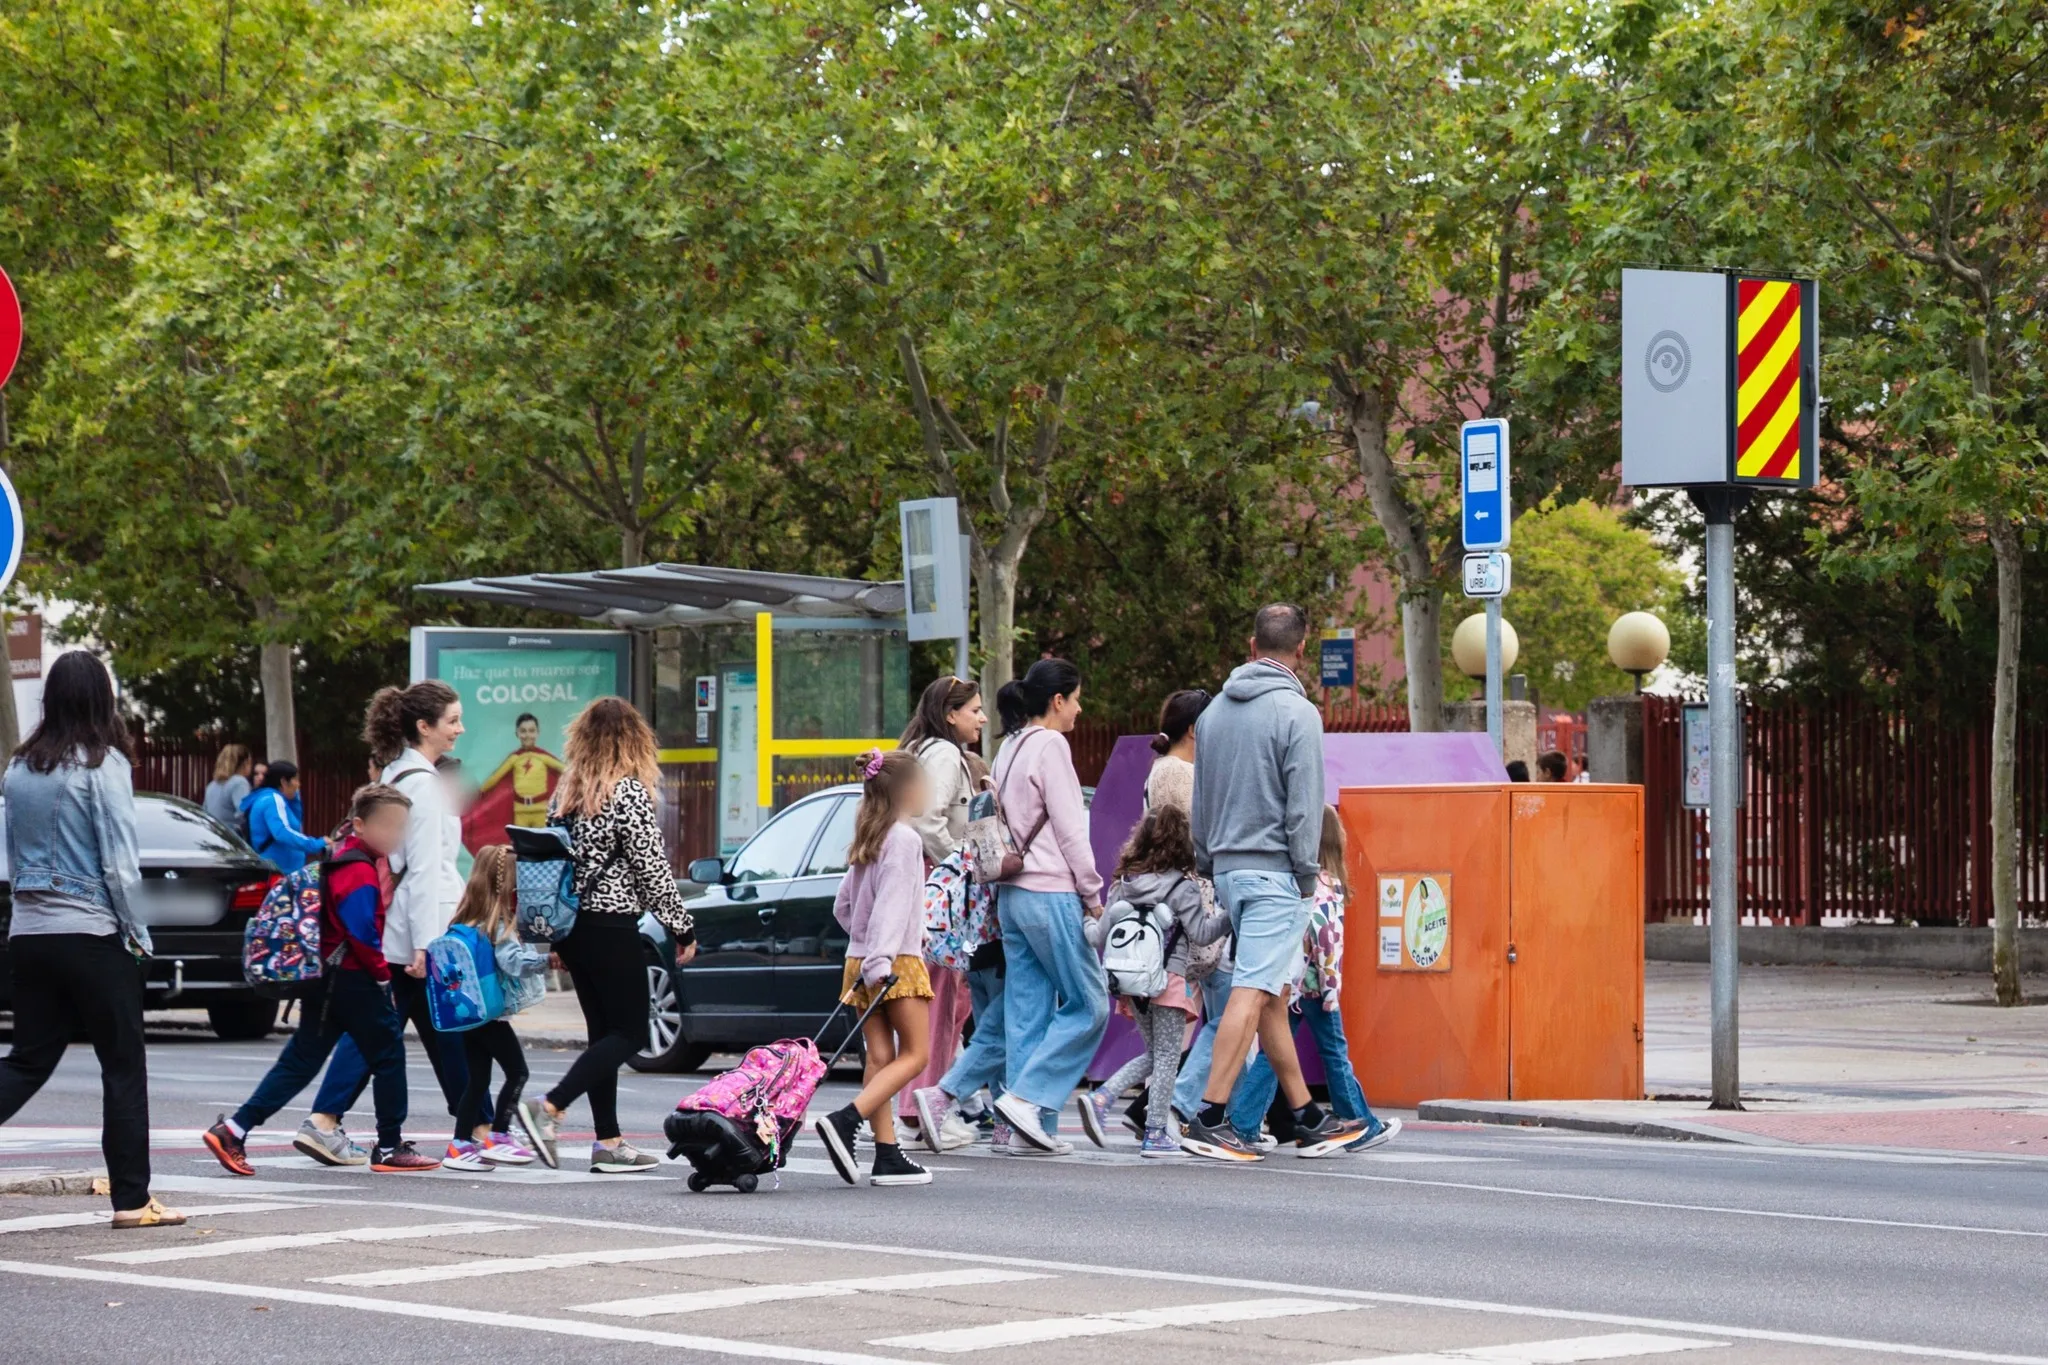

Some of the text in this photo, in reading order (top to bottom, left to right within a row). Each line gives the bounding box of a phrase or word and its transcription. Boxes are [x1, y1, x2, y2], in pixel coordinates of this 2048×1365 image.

[453, 664, 601, 682] Haz que tu marca sea
[476, 682, 578, 704] COLOSAL
[1424, 917, 1447, 932] ACEITE
[1411, 949, 1439, 966] COCINA
[1423, 945, 1431, 954] de
